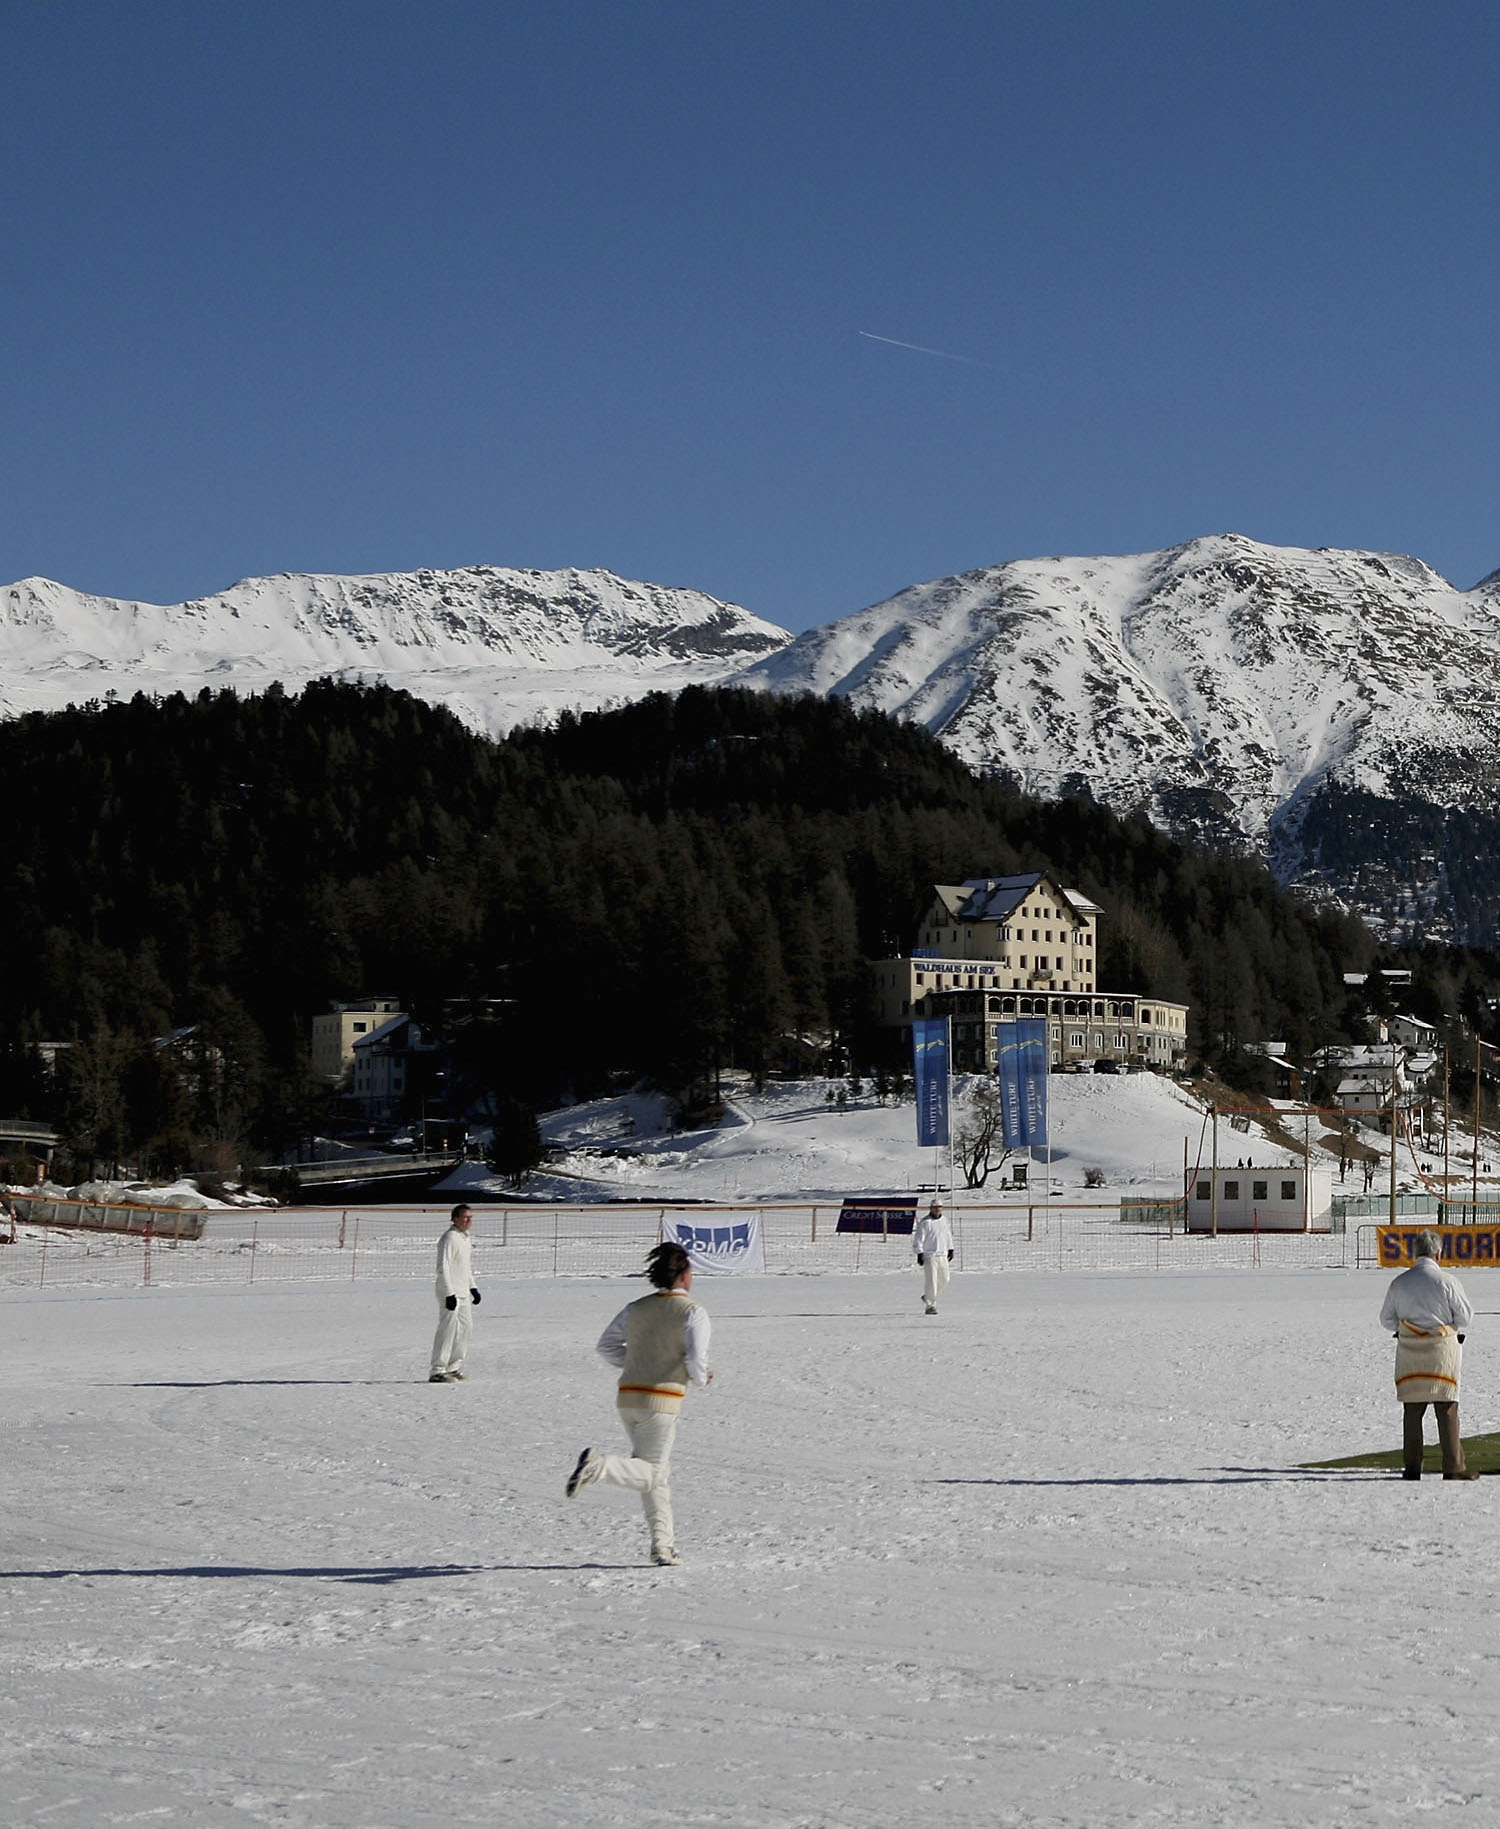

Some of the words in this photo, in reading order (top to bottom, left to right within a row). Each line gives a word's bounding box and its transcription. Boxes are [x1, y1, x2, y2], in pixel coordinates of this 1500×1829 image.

[913, 963, 962, 974] WALDHAUS
[963, 965, 977, 974] AM
[979, 966, 996, 975] SEE
[929, 1079, 937, 1102] TURF
[1008, 1082, 1016, 1105] TURF
[1027, 1079, 1035, 1102] TURF
[929, 1104, 937, 1134] WHITE
[1010, 1106, 1018, 1136] WHITE
[875, 1210, 903, 1219] SUSSE
[678, 1236, 746, 1259] KPMG
